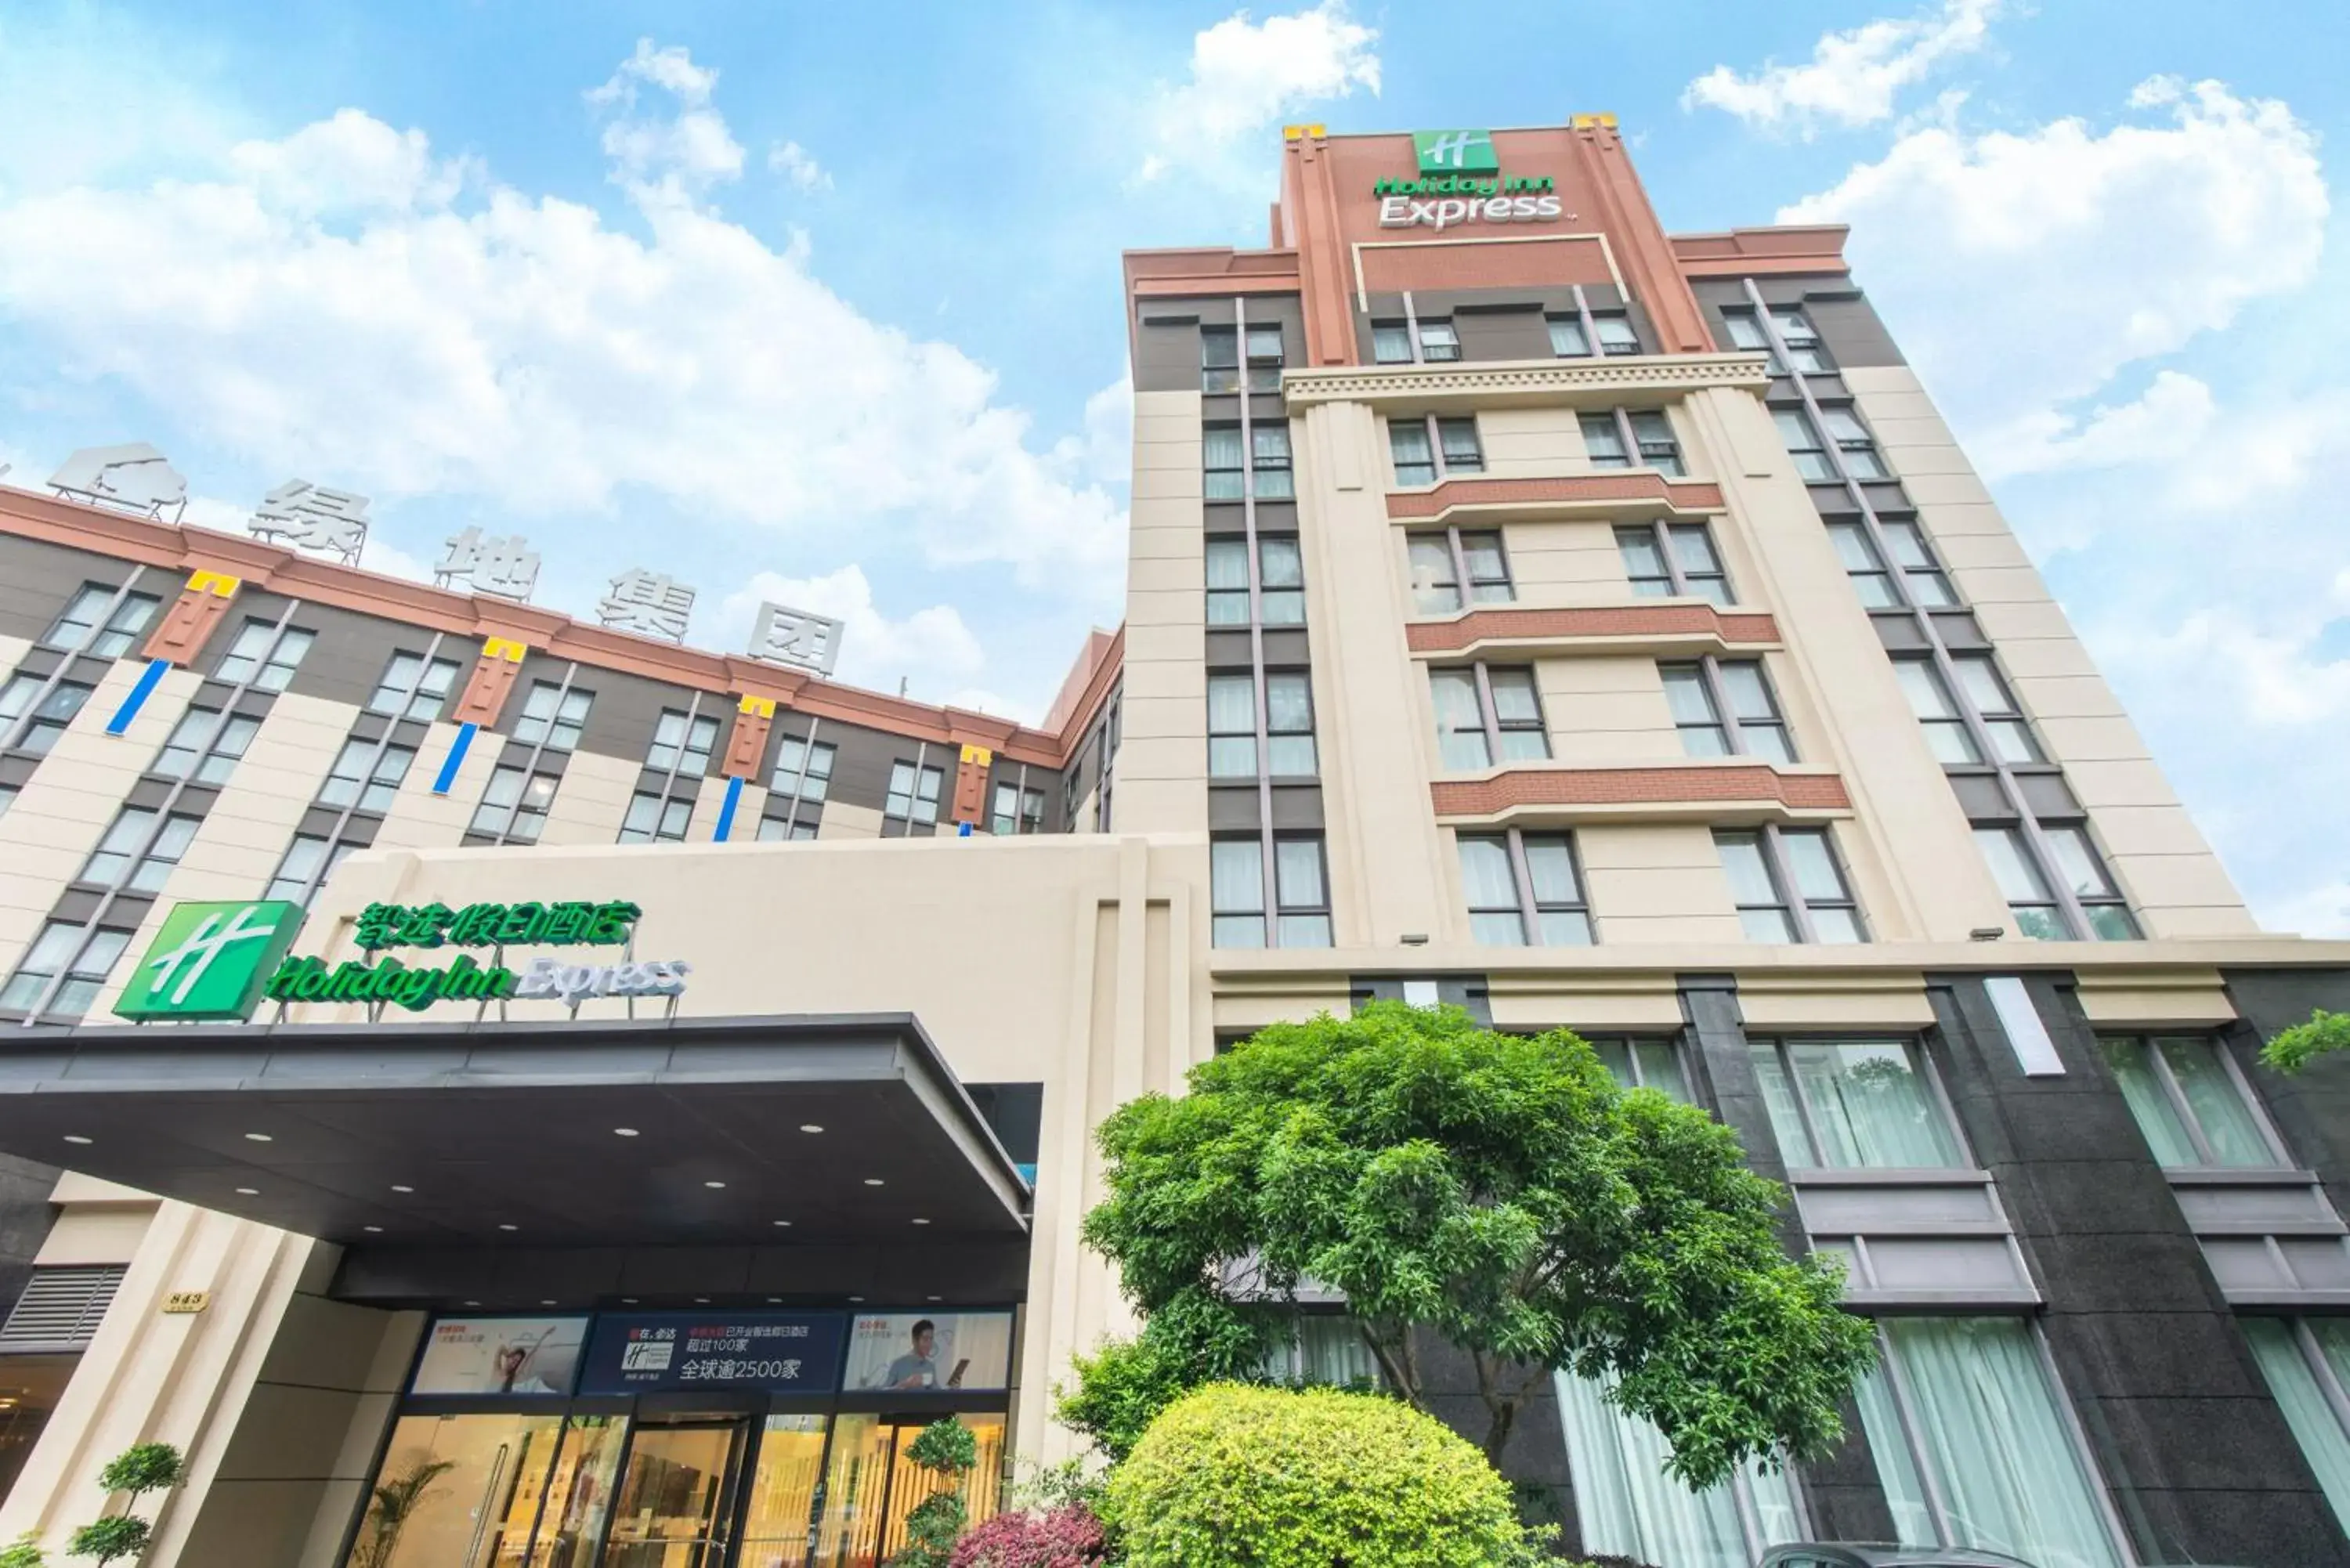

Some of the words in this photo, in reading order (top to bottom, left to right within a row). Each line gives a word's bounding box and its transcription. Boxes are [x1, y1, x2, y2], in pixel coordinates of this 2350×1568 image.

[1374, 175, 1499, 200] Holiday
[1504, 175, 1555, 195] Inn
[1379, 196, 1563, 233] Express
[247, 477, 846, 677] 绿地集团
[354, 900, 642, 950] 智选假日酒店
[264, 955, 439, 1012] Holiday
[438, 954, 520, 1002] Inn
[514, 957, 692, 1008] Express
[679, 1359, 803, 1380] 全球逾2500家
